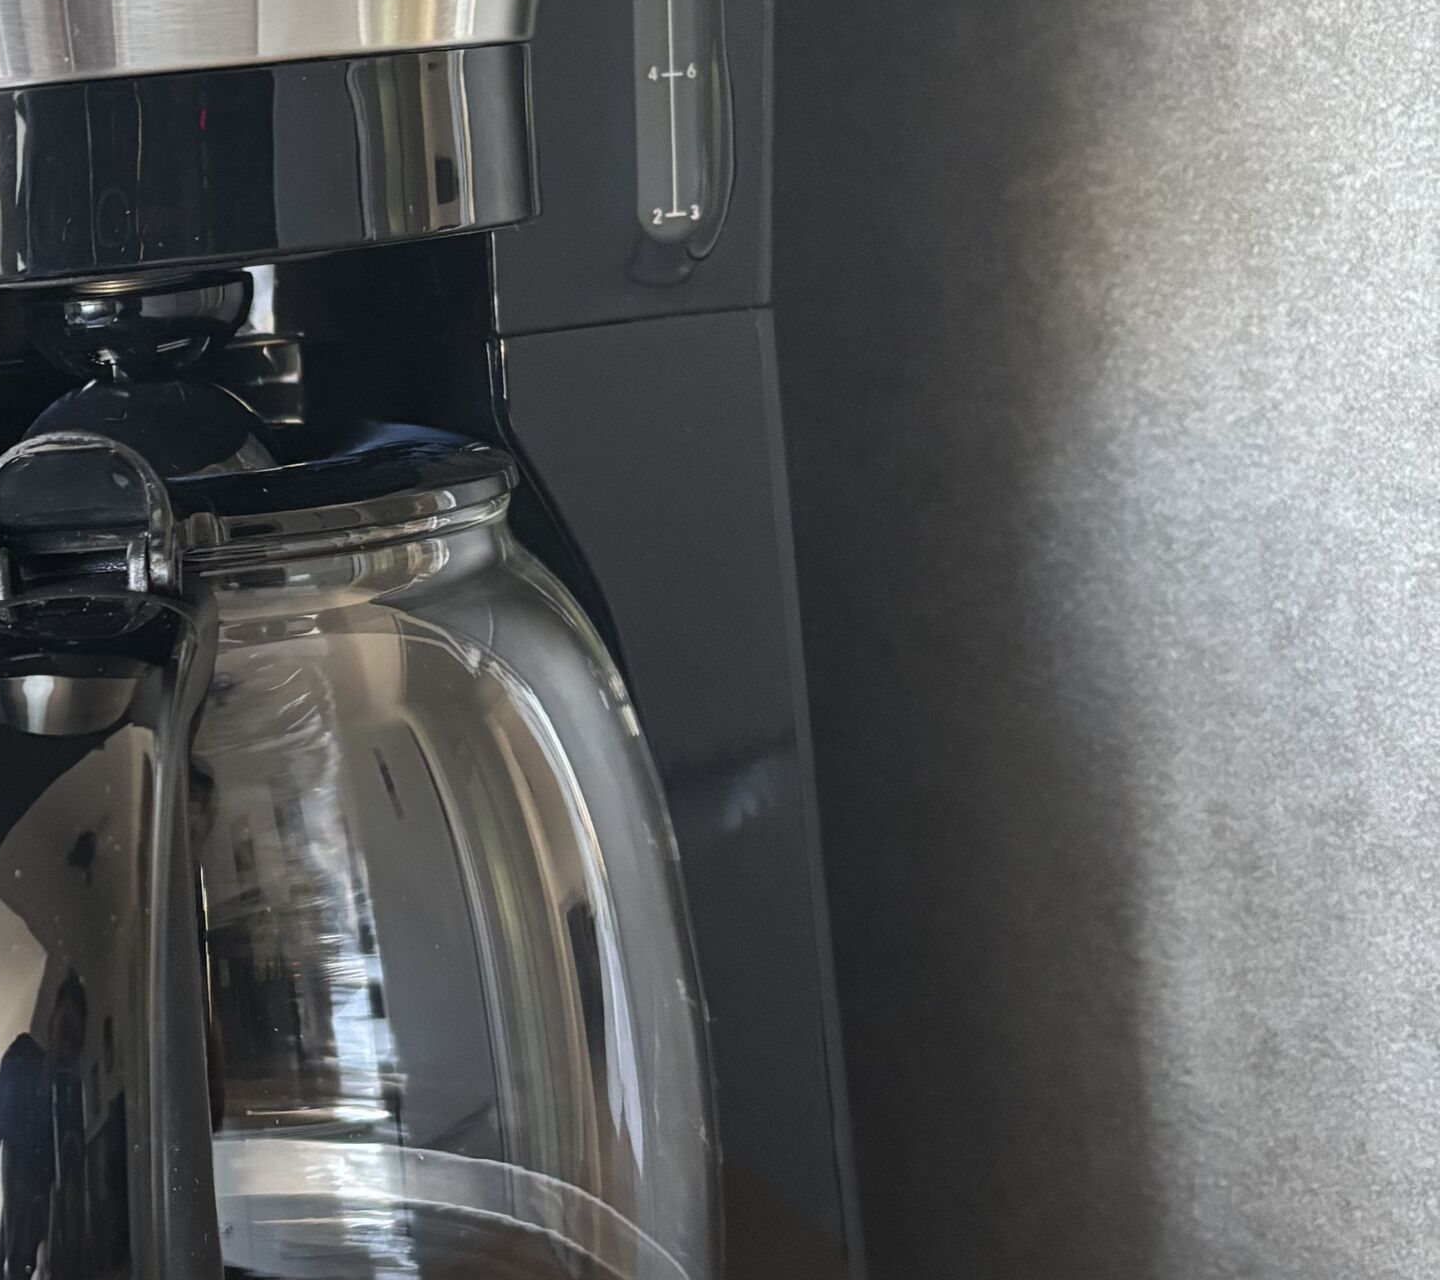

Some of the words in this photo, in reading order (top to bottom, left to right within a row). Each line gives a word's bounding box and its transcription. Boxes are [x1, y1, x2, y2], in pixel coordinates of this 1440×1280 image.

[648, 65, 658, 81] 4
[686, 62, 697, 79] 6
[652, 207, 663, 225] 2
[689, 204, 700, 221] 3
